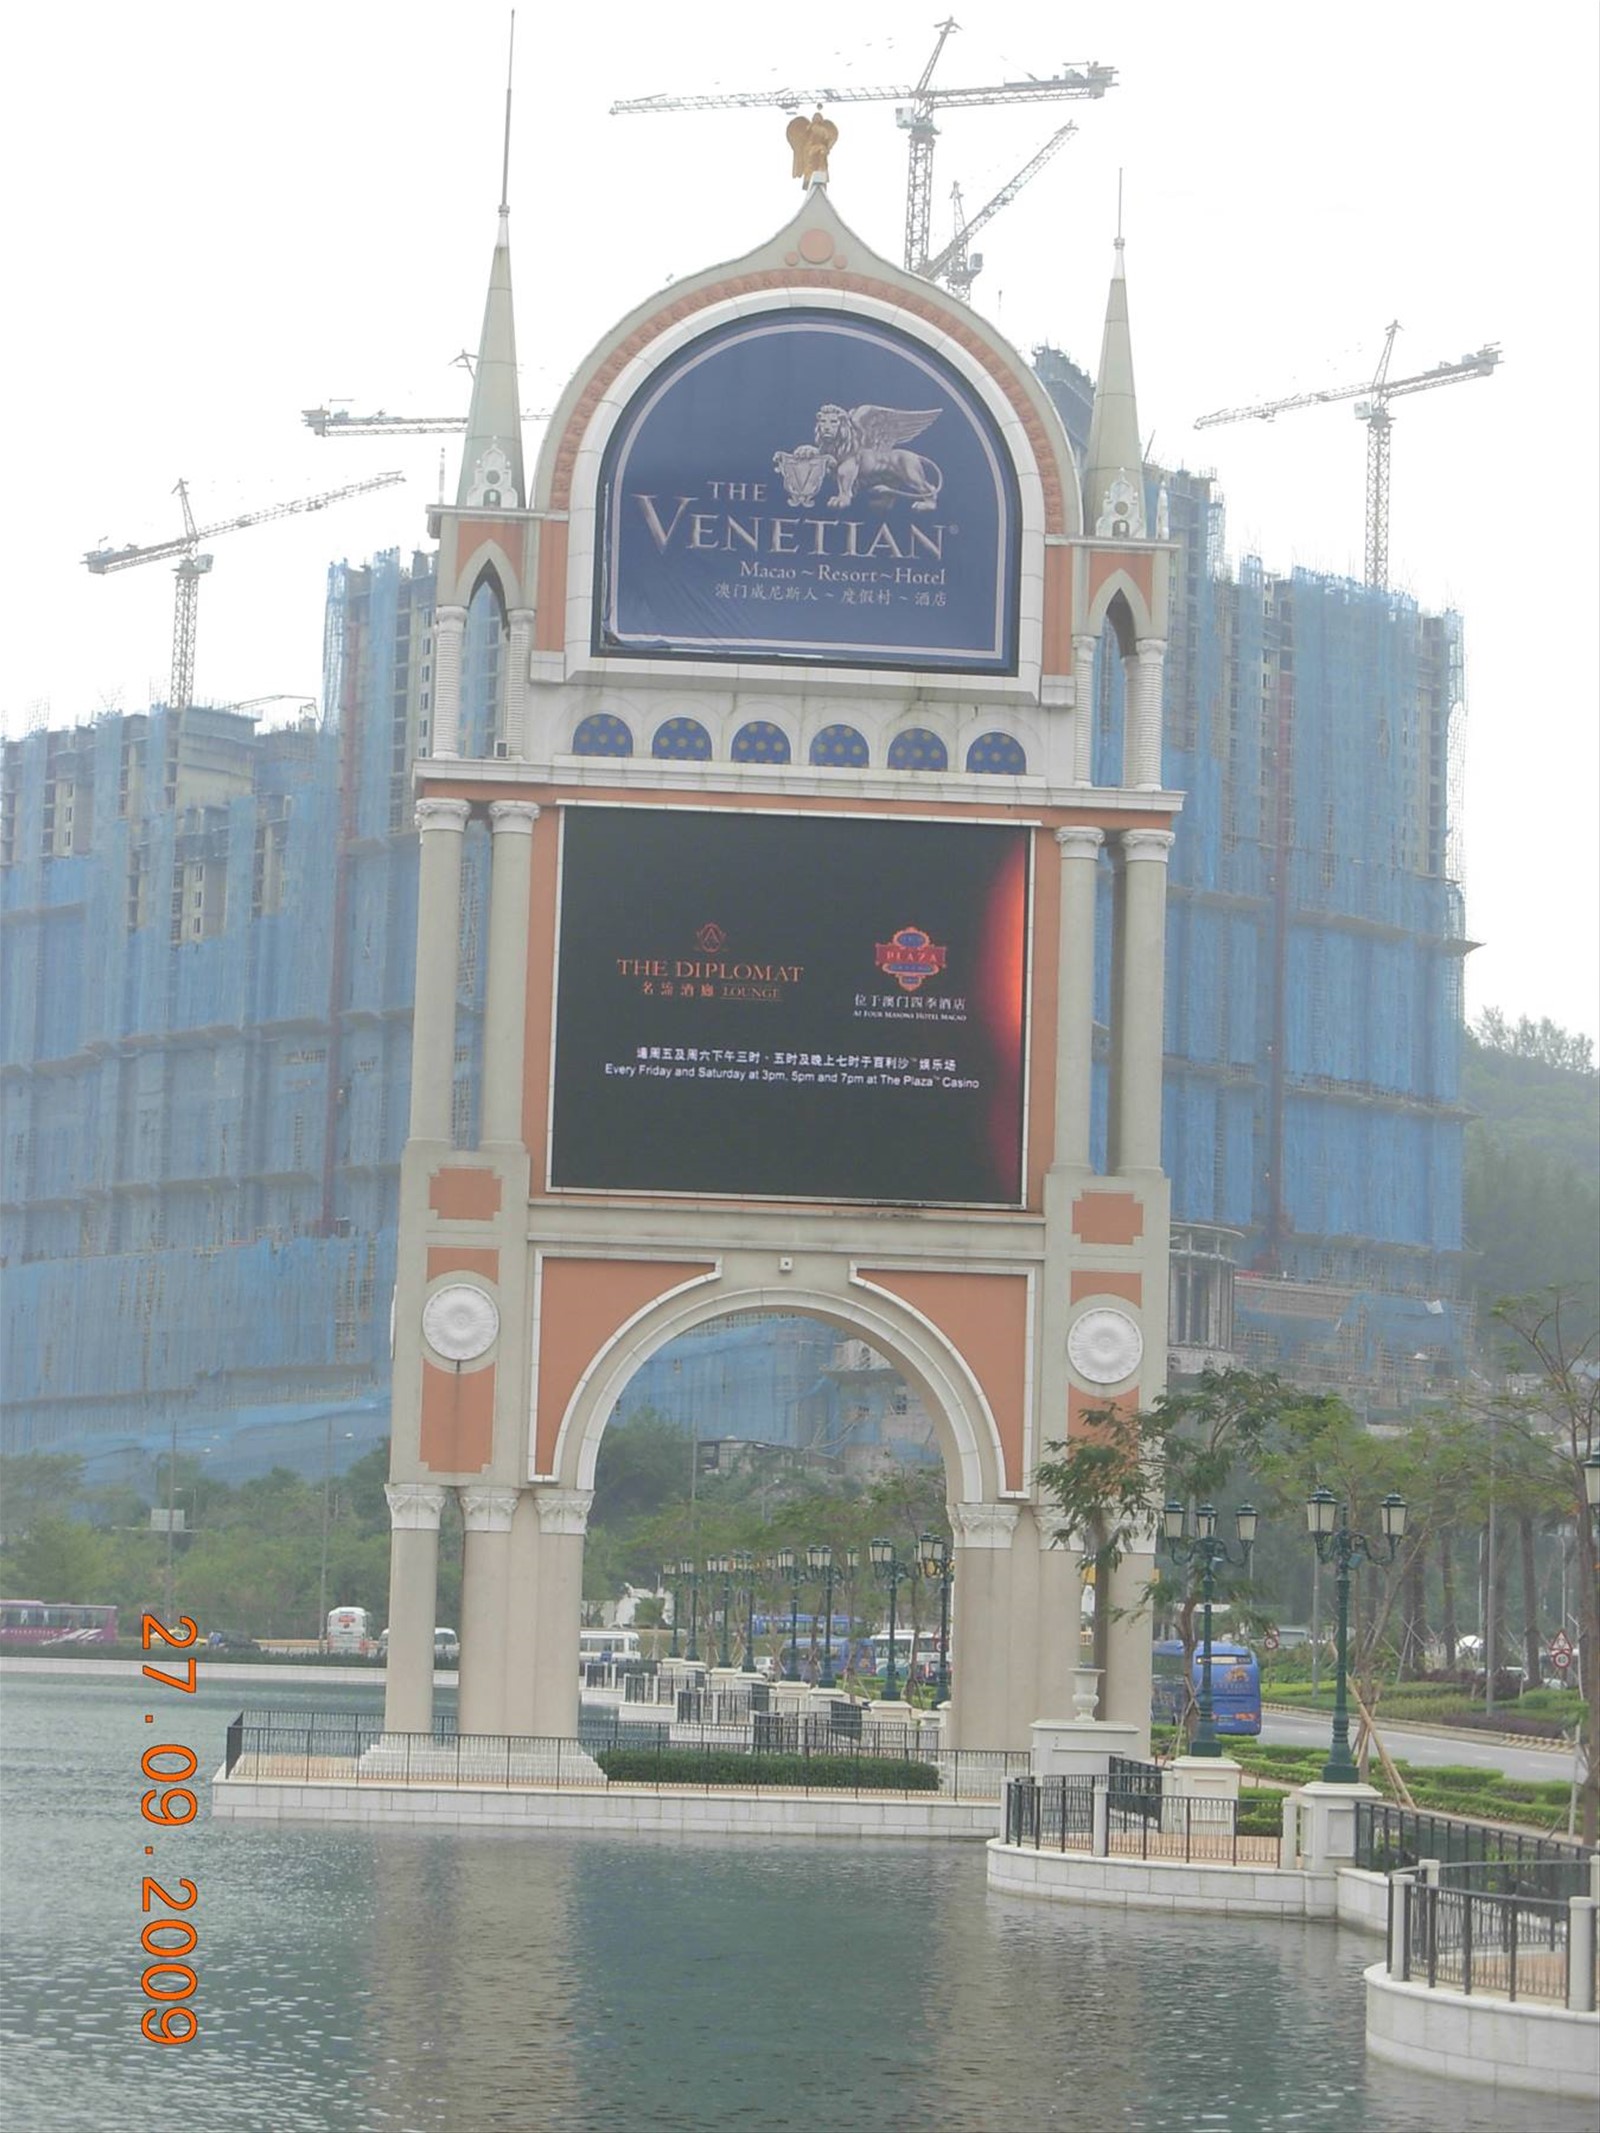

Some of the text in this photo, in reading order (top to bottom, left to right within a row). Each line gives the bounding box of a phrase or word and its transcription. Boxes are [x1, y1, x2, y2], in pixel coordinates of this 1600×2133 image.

[707, 481, 768, 502] THE
[631, 494, 947, 561] VENETIAN
[740, 561, 796, 579] Macao
[886, 951, 937, 962] PLAZA
[617, 959, 804, 982] THE DIPLOMAT
[722, 985, 781, 999] LOUNGE
[605, 1063, 636, 1077] Every
[638, 1064, 672, 1079] Friday
[675, 1066, 695, 1078] and
[698, 1066, 746, 1081] Saturday
[749, 1069, 759, 1080] at
[791, 1071, 815, 1084] 5pm
[817, 1072, 838, 1083] and
[841, 1073, 864, 1085] 7pm
[866, 1074, 878, 1085] at
[881, 1074, 900, 1086] The
[942, 1077, 980, 1089] Casino
